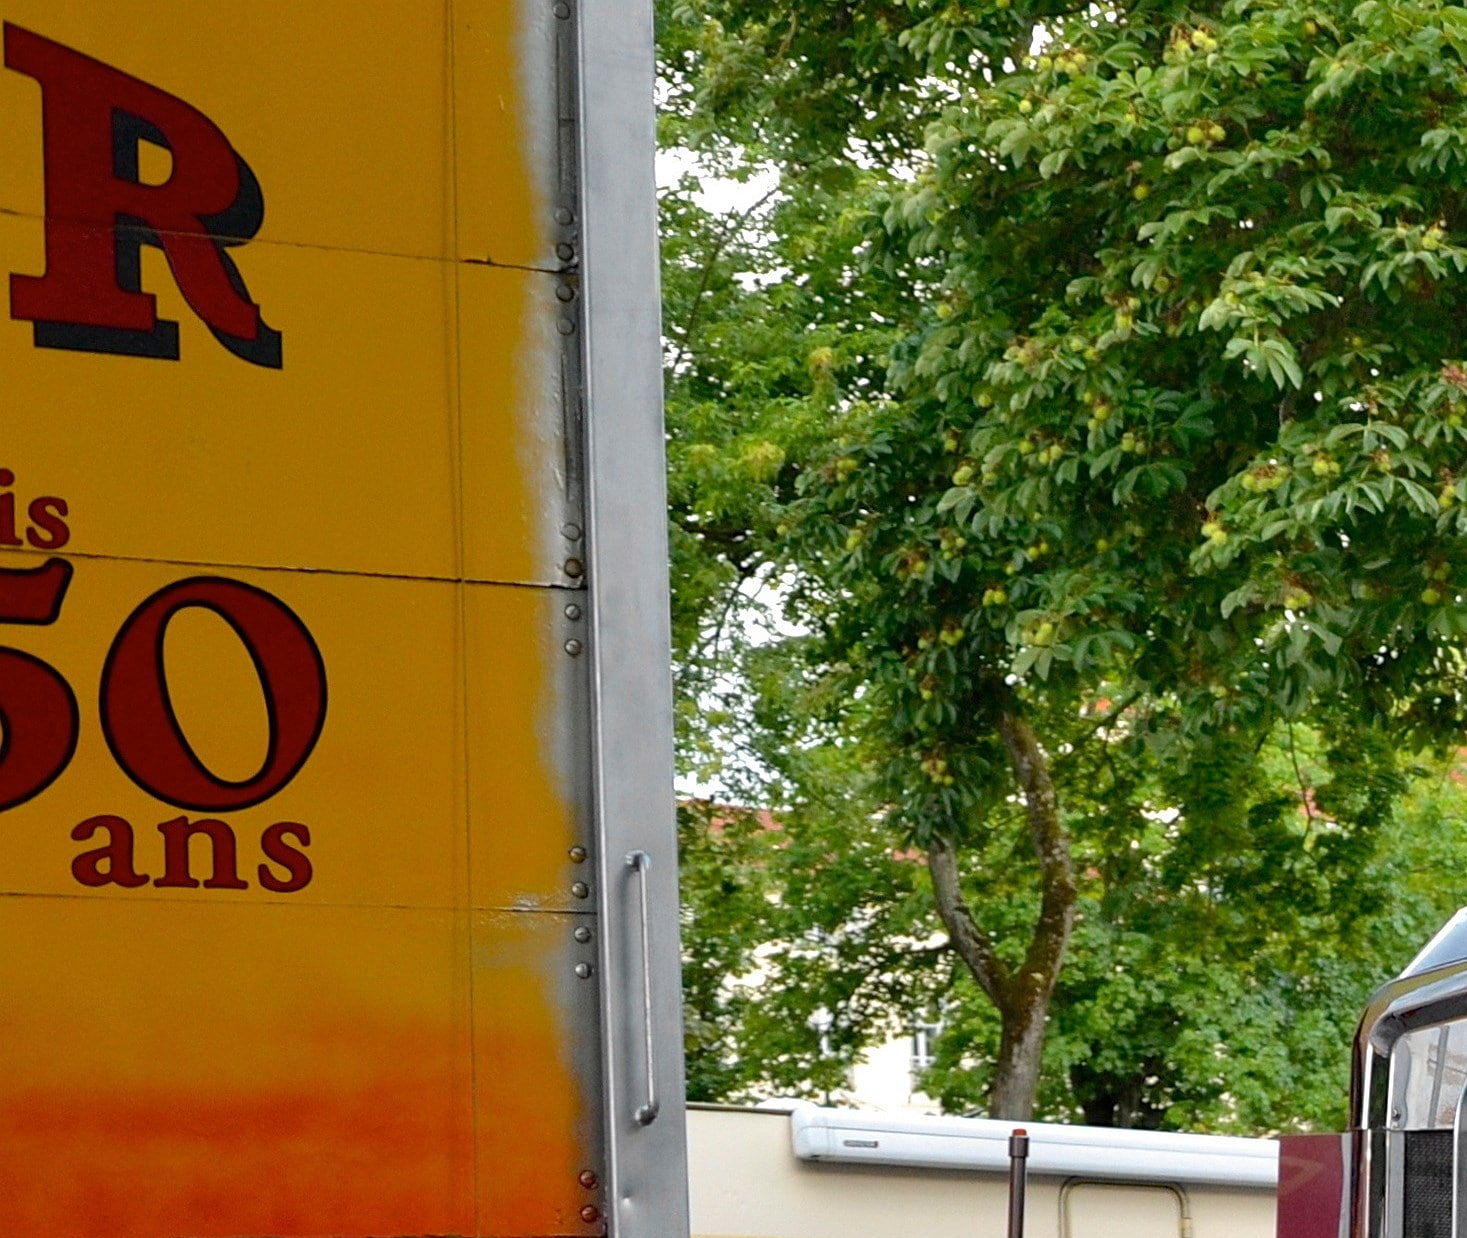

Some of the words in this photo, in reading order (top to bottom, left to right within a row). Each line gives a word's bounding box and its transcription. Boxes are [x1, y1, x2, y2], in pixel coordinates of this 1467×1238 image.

[3, 20, 283, 369] R
[0, 468, 70, 550] is
[71, 814, 313, 891] ans
